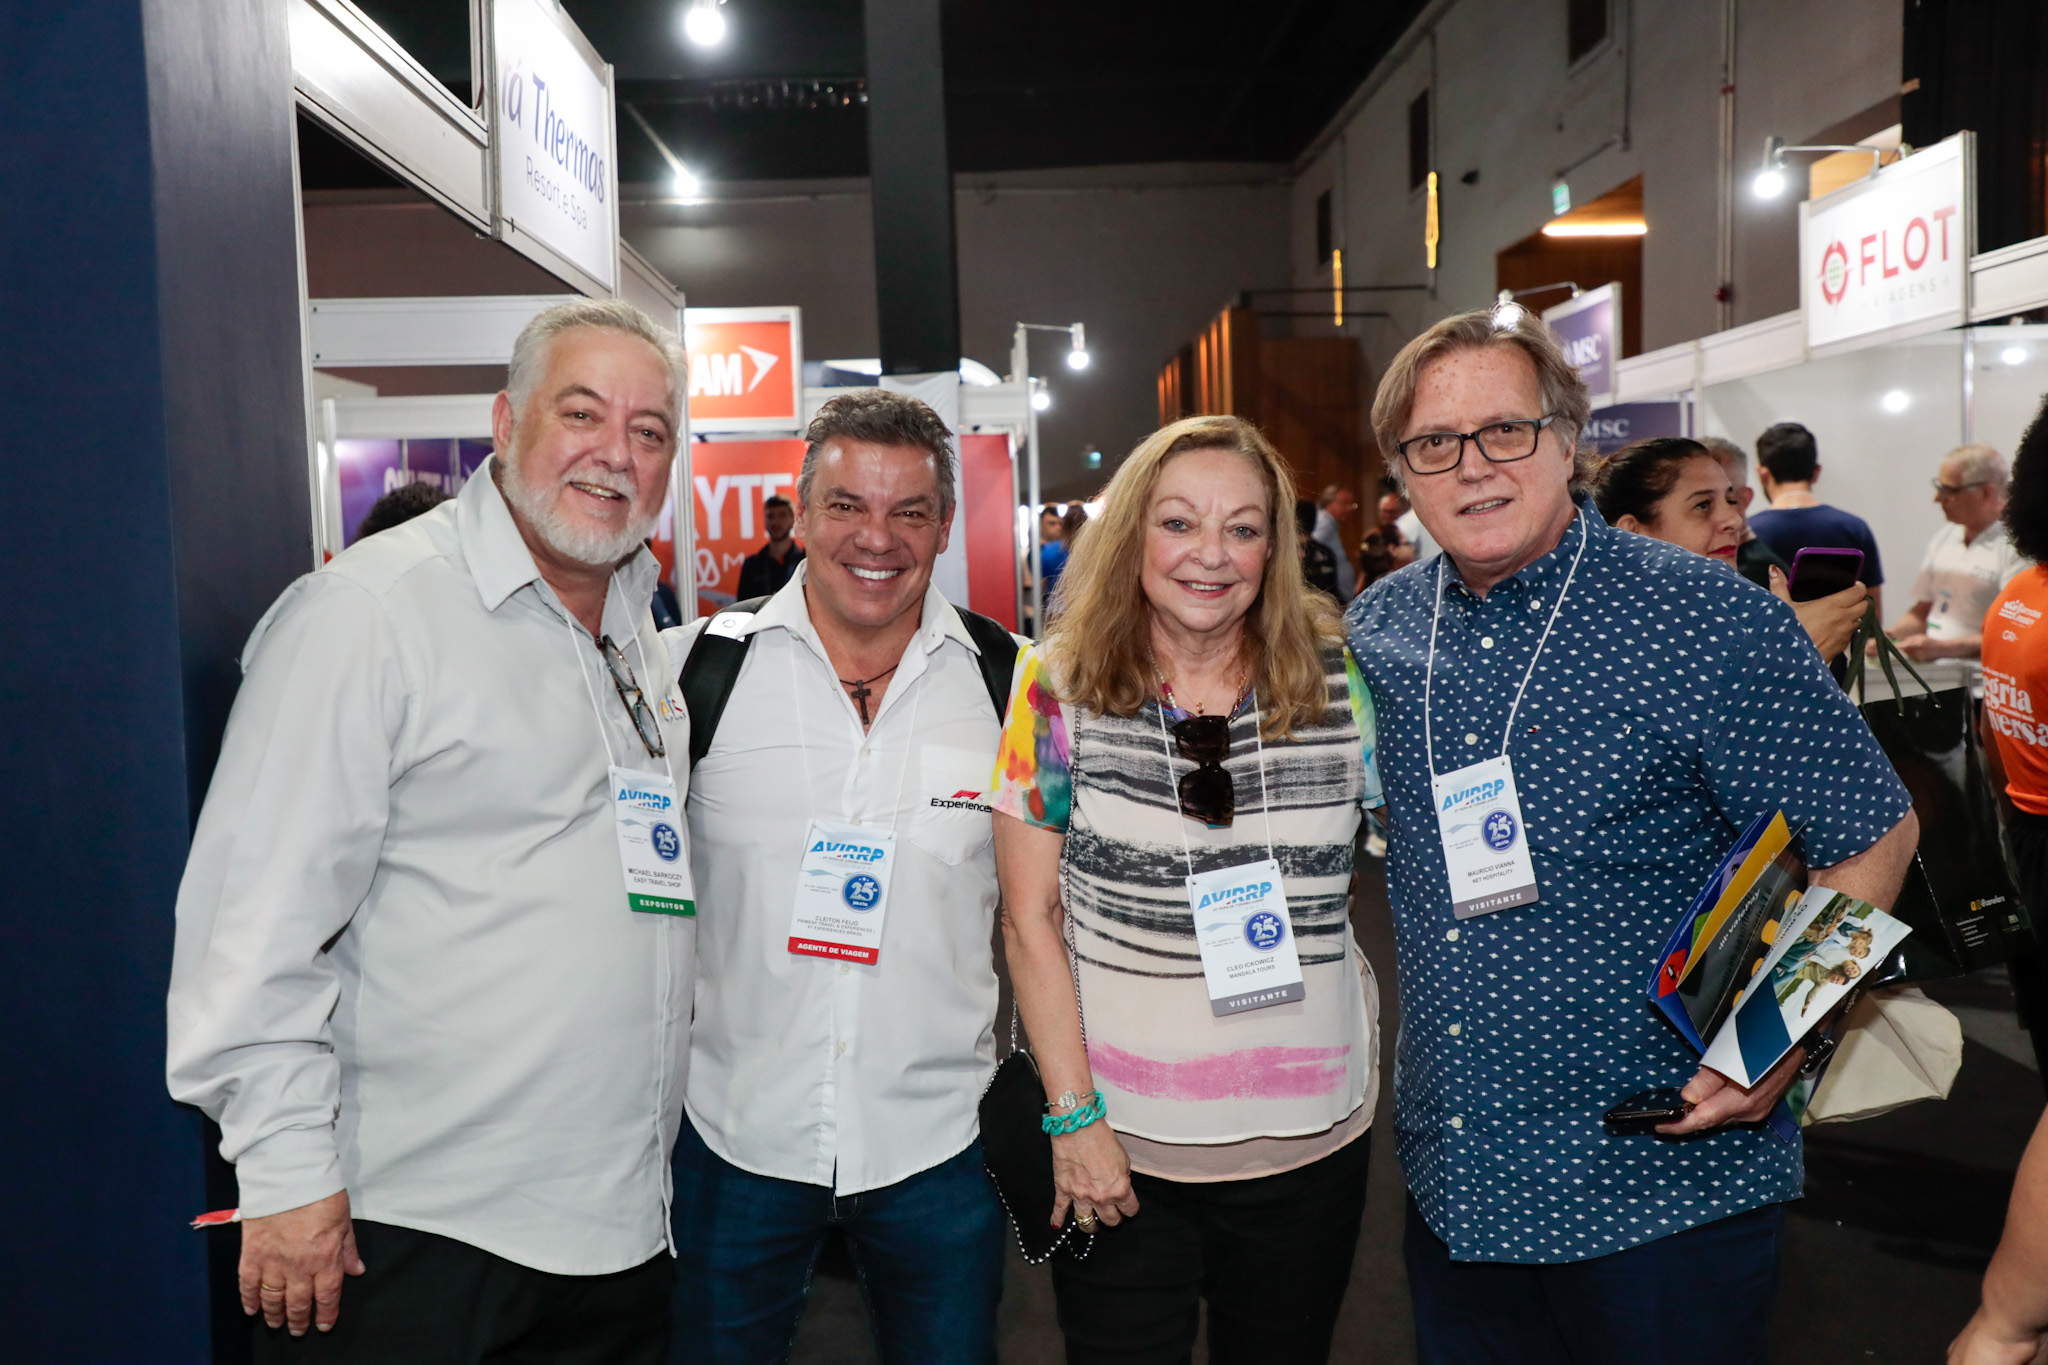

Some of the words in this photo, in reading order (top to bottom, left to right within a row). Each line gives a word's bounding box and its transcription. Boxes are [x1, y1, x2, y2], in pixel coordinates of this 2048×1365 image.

[532, 71, 605, 204] Thermas
[526, 155, 561, 209] Resort
[563, 194, 569, 215] e
[571, 194, 587, 231] Spa
[1860, 204, 1957, 287] FLOT
[1571, 332, 1602, 366] MSC
[617, 788, 671, 810] AVIRRP
[1442, 778, 1504, 812] AVIRRP
[809, 840, 884, 862] AVIRRP
[628, 867, 652, 877] MICHAEL
[1468, 866, 1494, 877] MAURICIO
[1495, 860, 1515, 870] VIANNA
[1482, 869, 1514, 881] HOSPITALITY
[648, 878, 667, 886] TRAVEL
[849, 882, 876, 902] 25
[1198, 882, 1272, 910] AVIRRP
[640, 899, 684, 910] EXPOSITOR
[1469, 892, 1522, 912] VISITANTE
[814, 926, 845, 934] EXPERIENCES
[816, 916, 840, 924] CLEITON
[842, 918, 859, 926] FEIJÓ
[841, 925, 872, 933] EXPERIENCES
[1251, 916, 1278, 942] 25
[798, 943, 828, 953] AGENTE
[840, 949, 869, 958] VIAGEM
[1227, 964, 1243, 972] CLEO
[1245, 956, 1275, 968] ICKOWICZ
[1229, 969, 1256, 979] MANDALA
[1229, 990, 1288, 1008] VISITANTE
